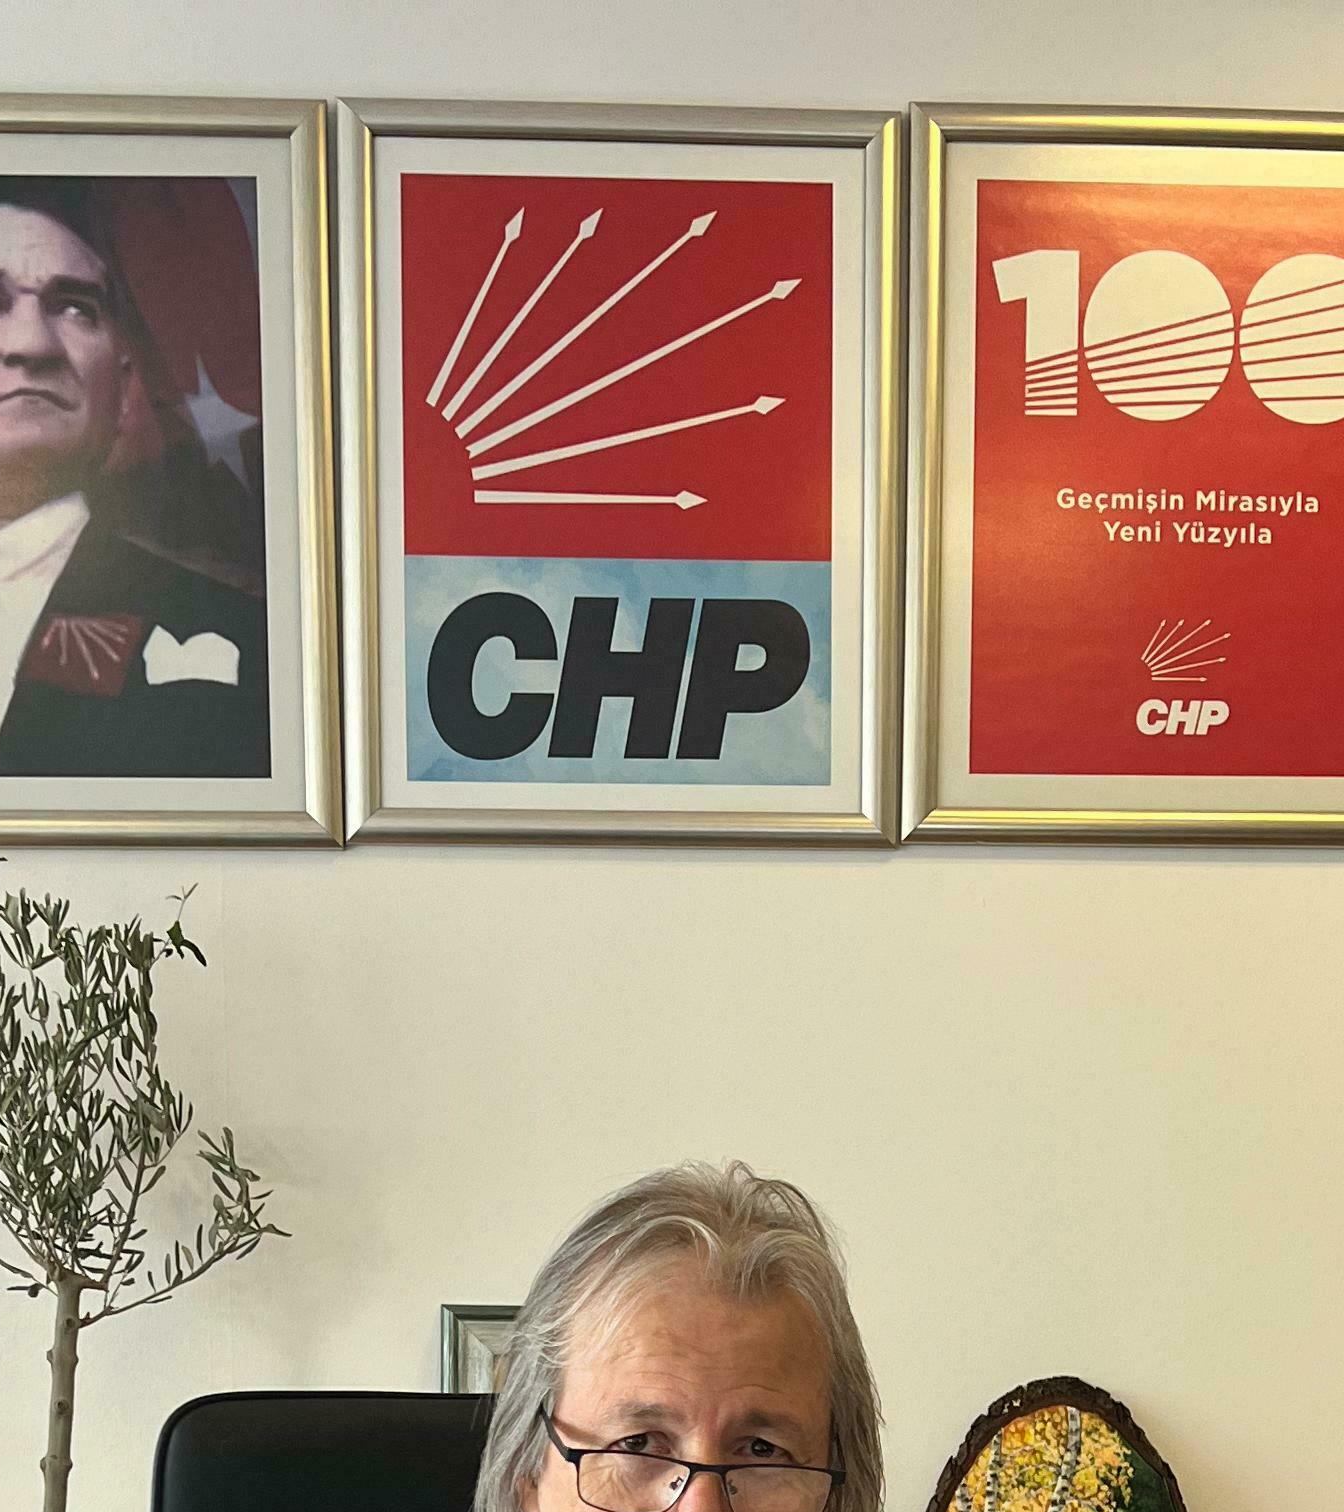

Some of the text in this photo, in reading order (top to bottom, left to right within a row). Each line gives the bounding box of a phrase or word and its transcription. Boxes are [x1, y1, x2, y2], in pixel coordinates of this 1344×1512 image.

[1057, 488, 1320, 518] Geçmişin Mirasıyla
[1102, 519, 1273, 551] Yeni Yüzyıla
[426, 591, 811, 761] CHP
[1136, 699, 1230, 736] CHP
